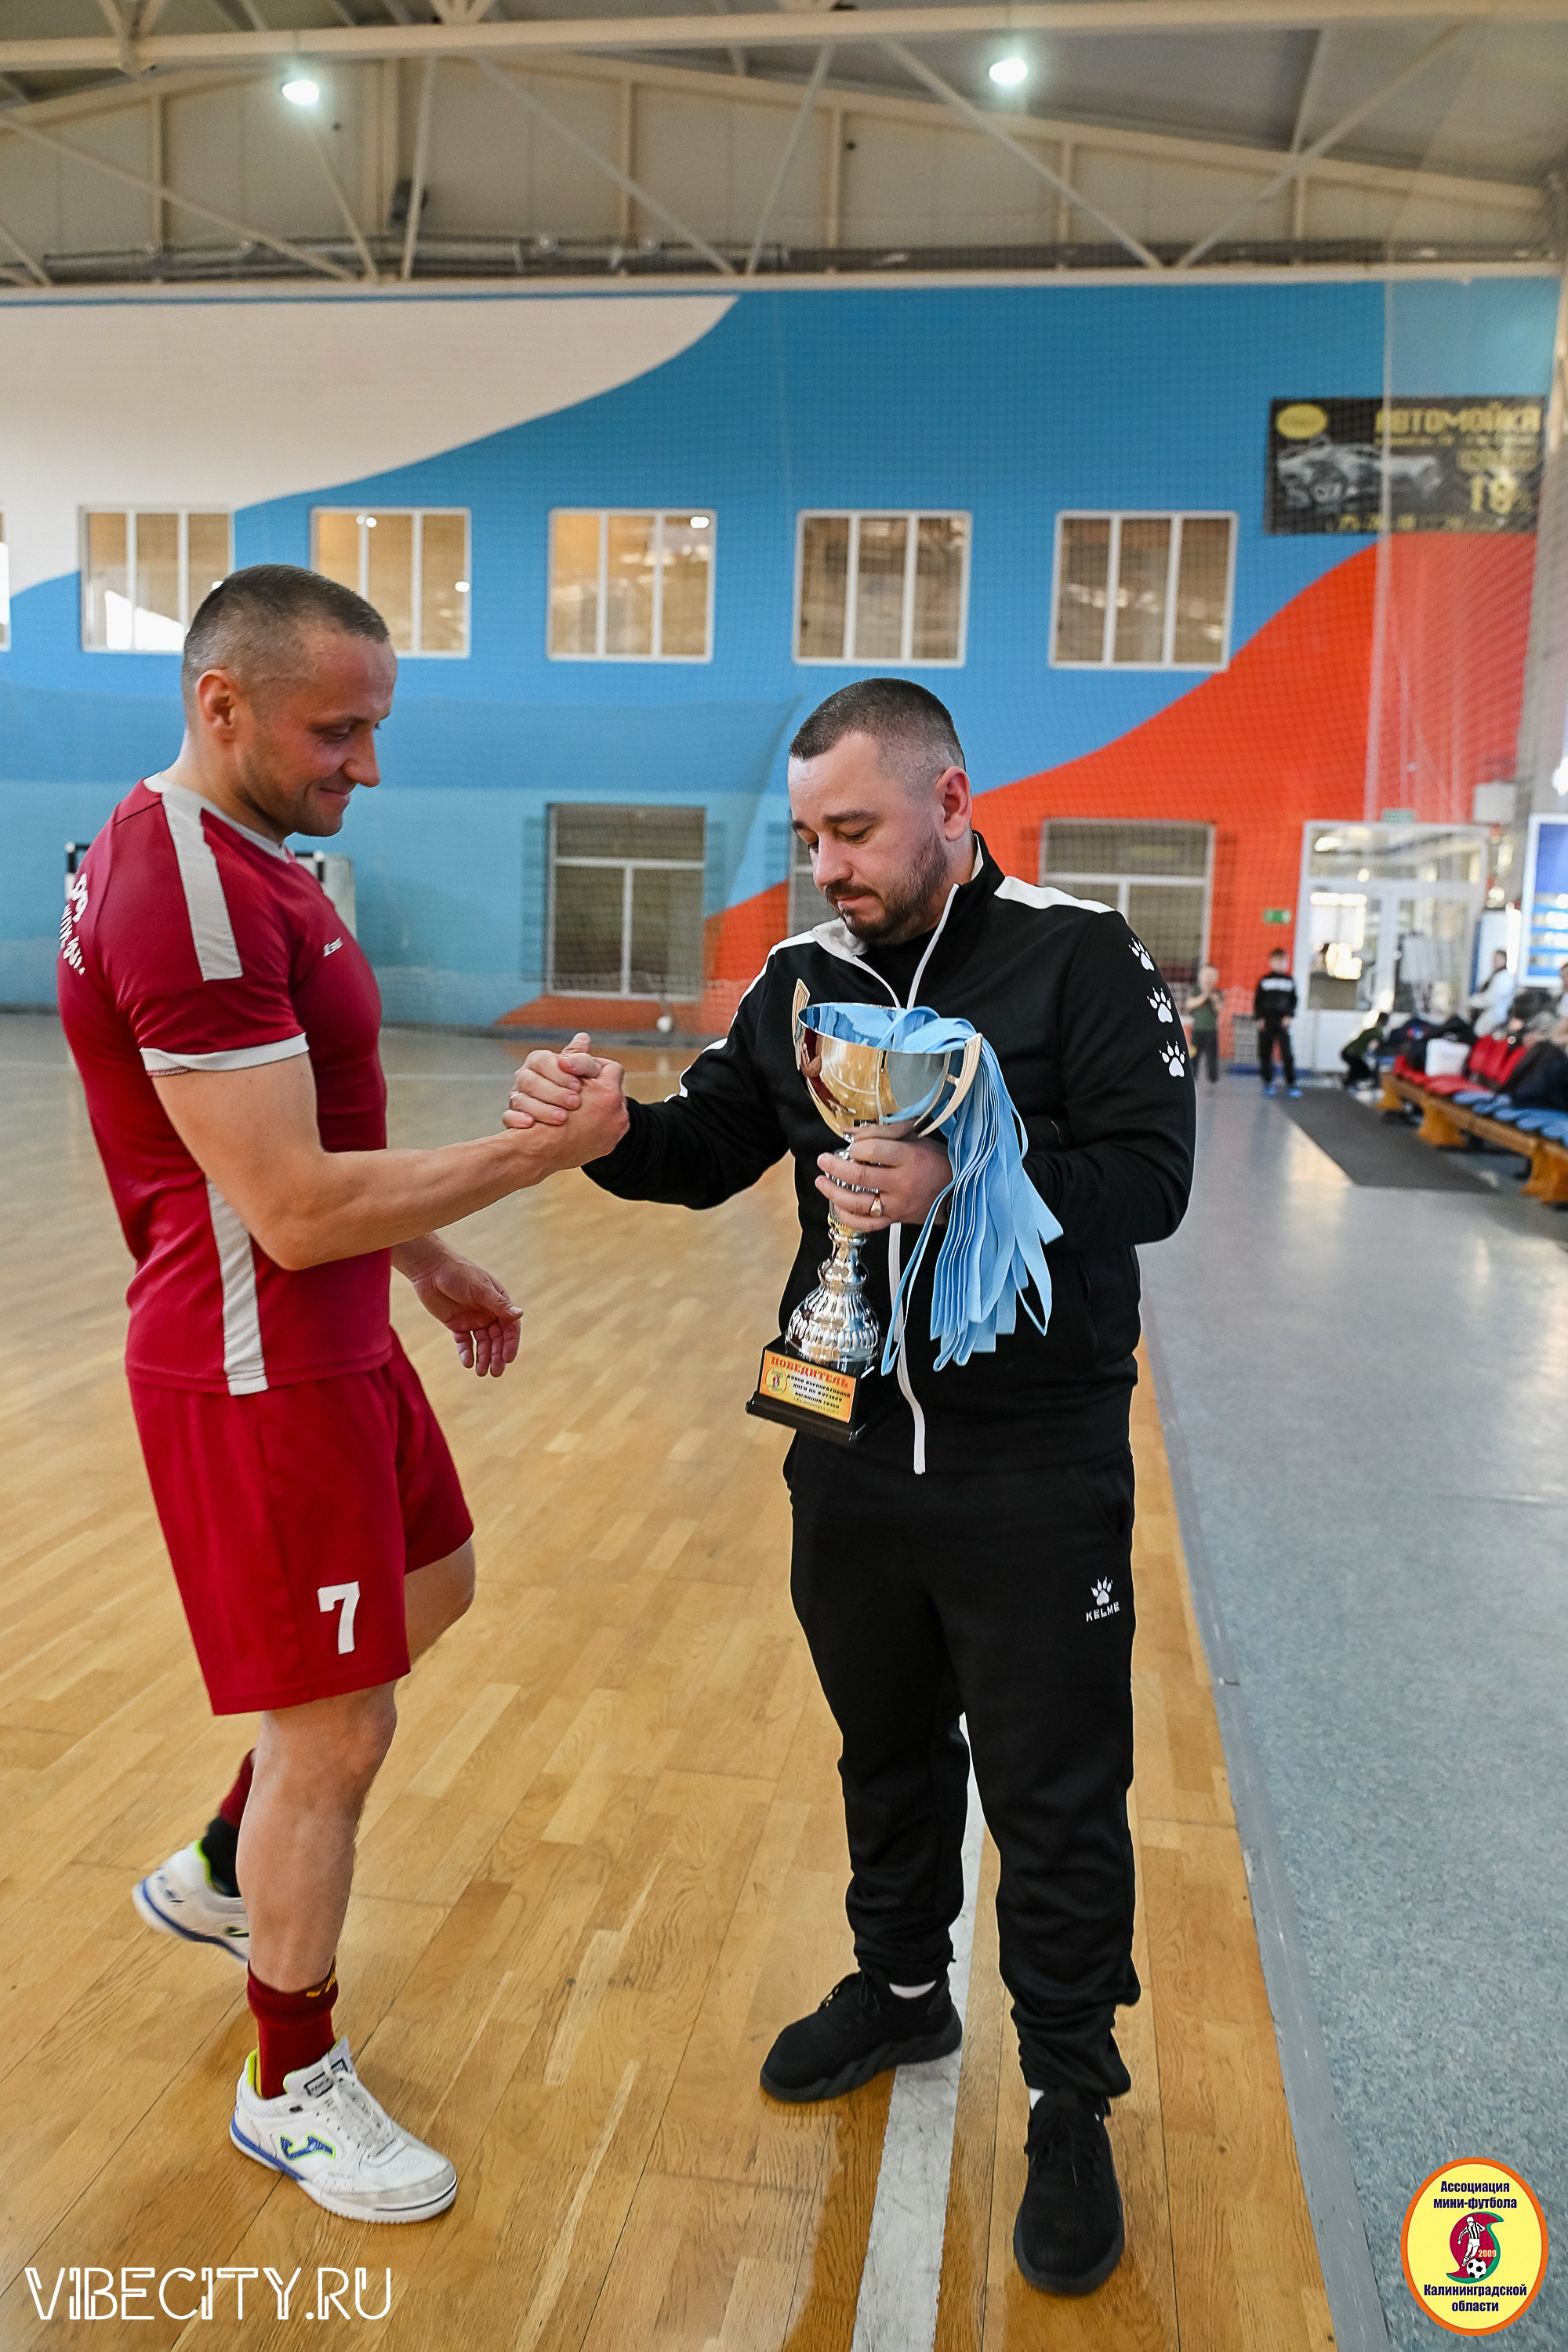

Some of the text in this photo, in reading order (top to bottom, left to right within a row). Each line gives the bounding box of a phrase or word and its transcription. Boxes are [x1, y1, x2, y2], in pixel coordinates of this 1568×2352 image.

[770, 1356, 848, 1387] ПОБЕДИТЕЛЬ
[317, 1581, 361, 1654] 7
[1086, 1601, 1120, 1622] KELME
